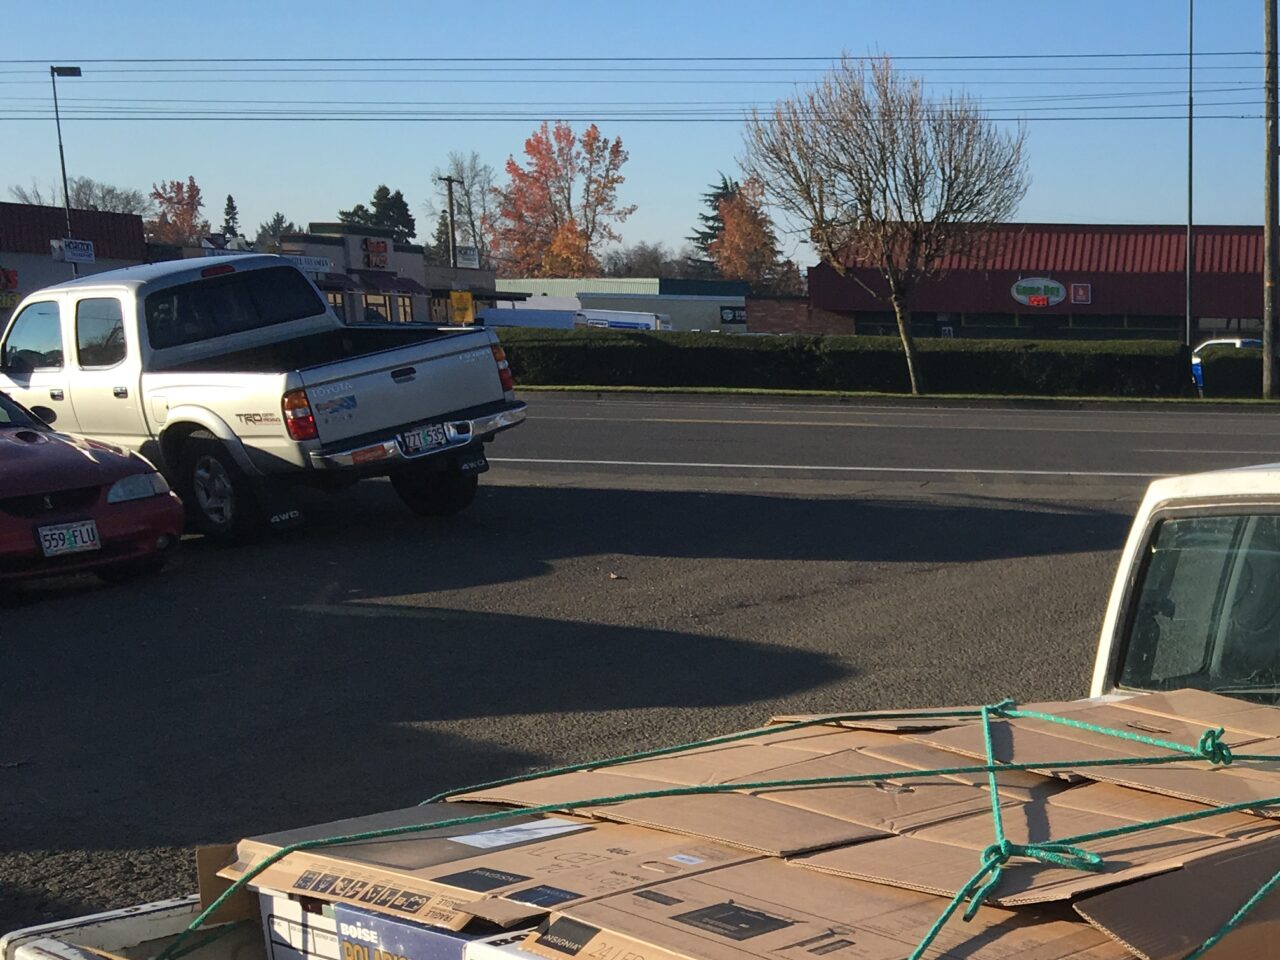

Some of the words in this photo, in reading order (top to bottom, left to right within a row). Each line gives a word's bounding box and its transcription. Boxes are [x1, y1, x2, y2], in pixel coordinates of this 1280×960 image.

[312, 383, 352, 398] TOYOTA
[235, 413, 262, 425] TRD
[427, 427, 444, 442] 535
[43, 532, 66, 549] 559
[72, 527, 96, 545] FLU
[542, 934, 578, 951] INSIGNIA
[589, 942, 608, 960] 24
